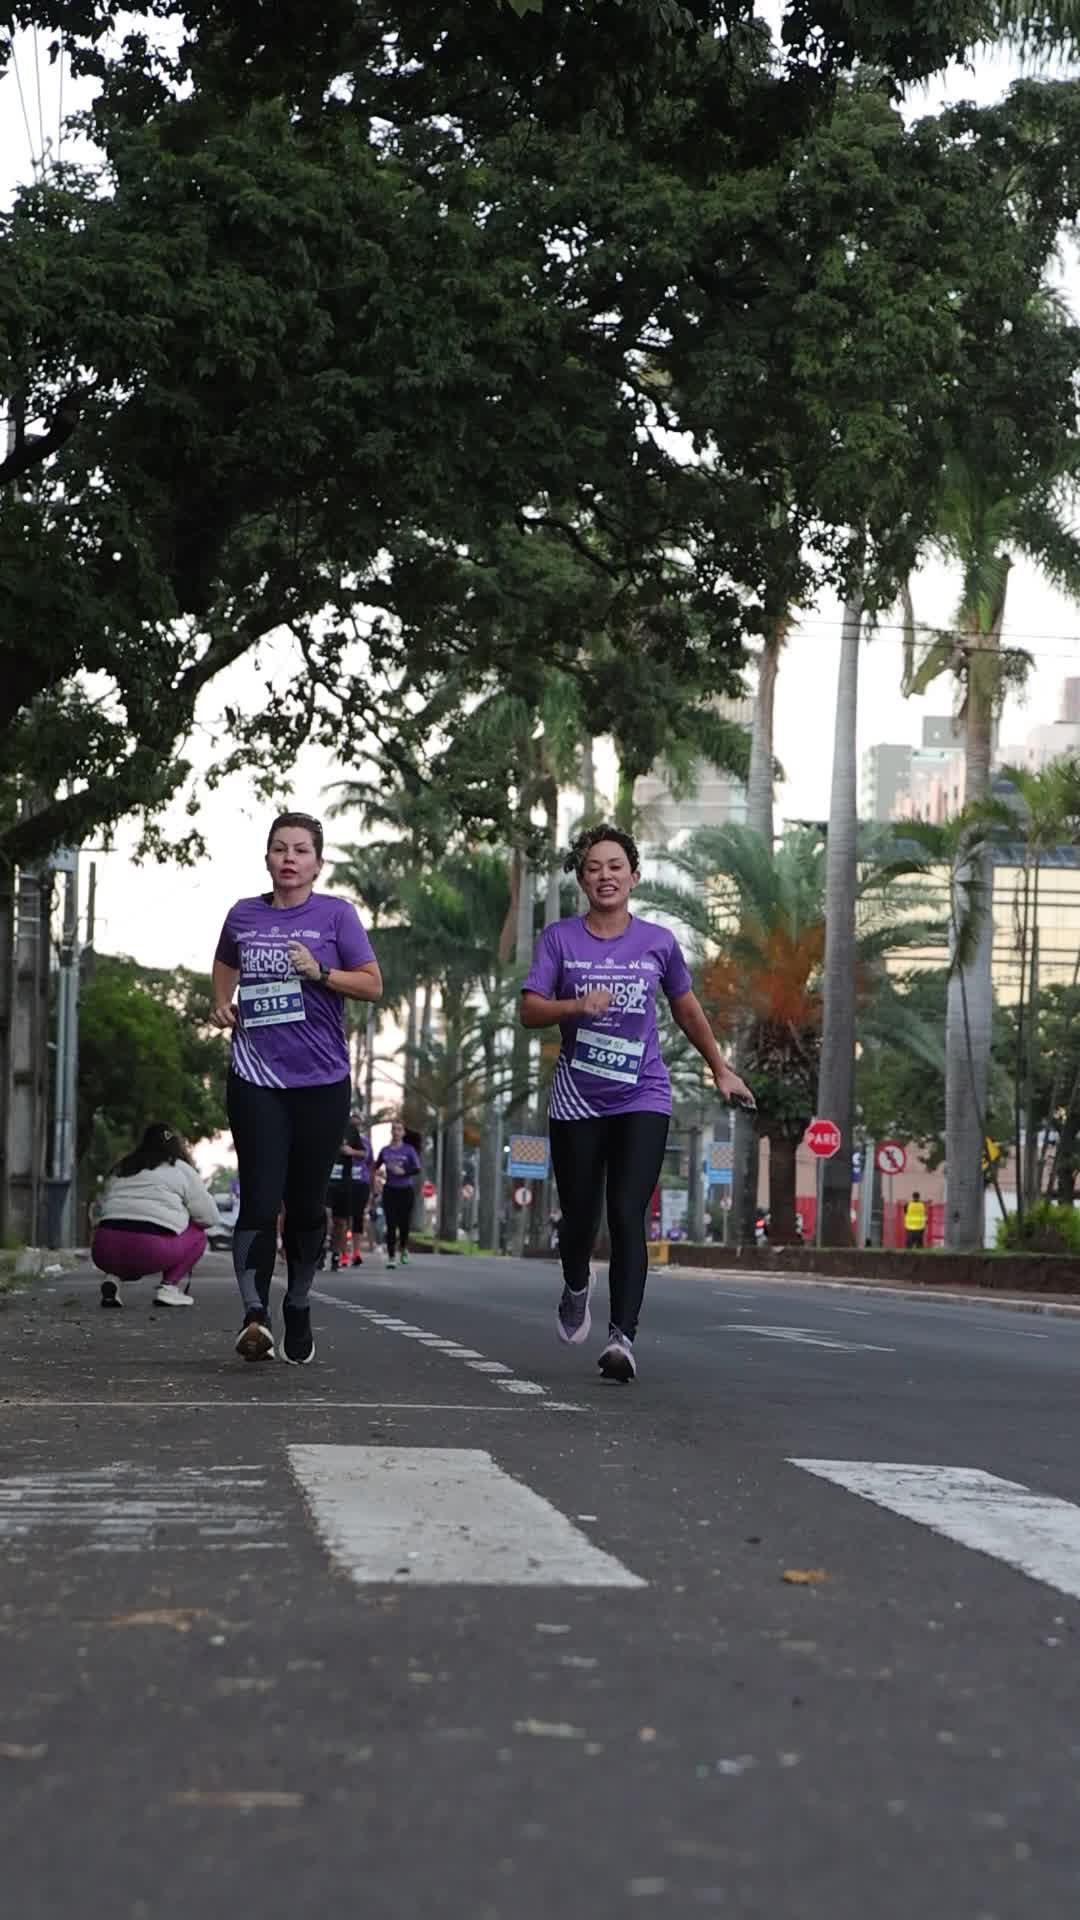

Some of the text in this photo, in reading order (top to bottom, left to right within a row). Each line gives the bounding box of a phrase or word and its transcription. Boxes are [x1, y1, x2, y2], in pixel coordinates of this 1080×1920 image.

[254, 996, 289, 1012] 6315
[587, 1047, 627, 1067] 5699
[808, 1132, 837, 1145] PARE
